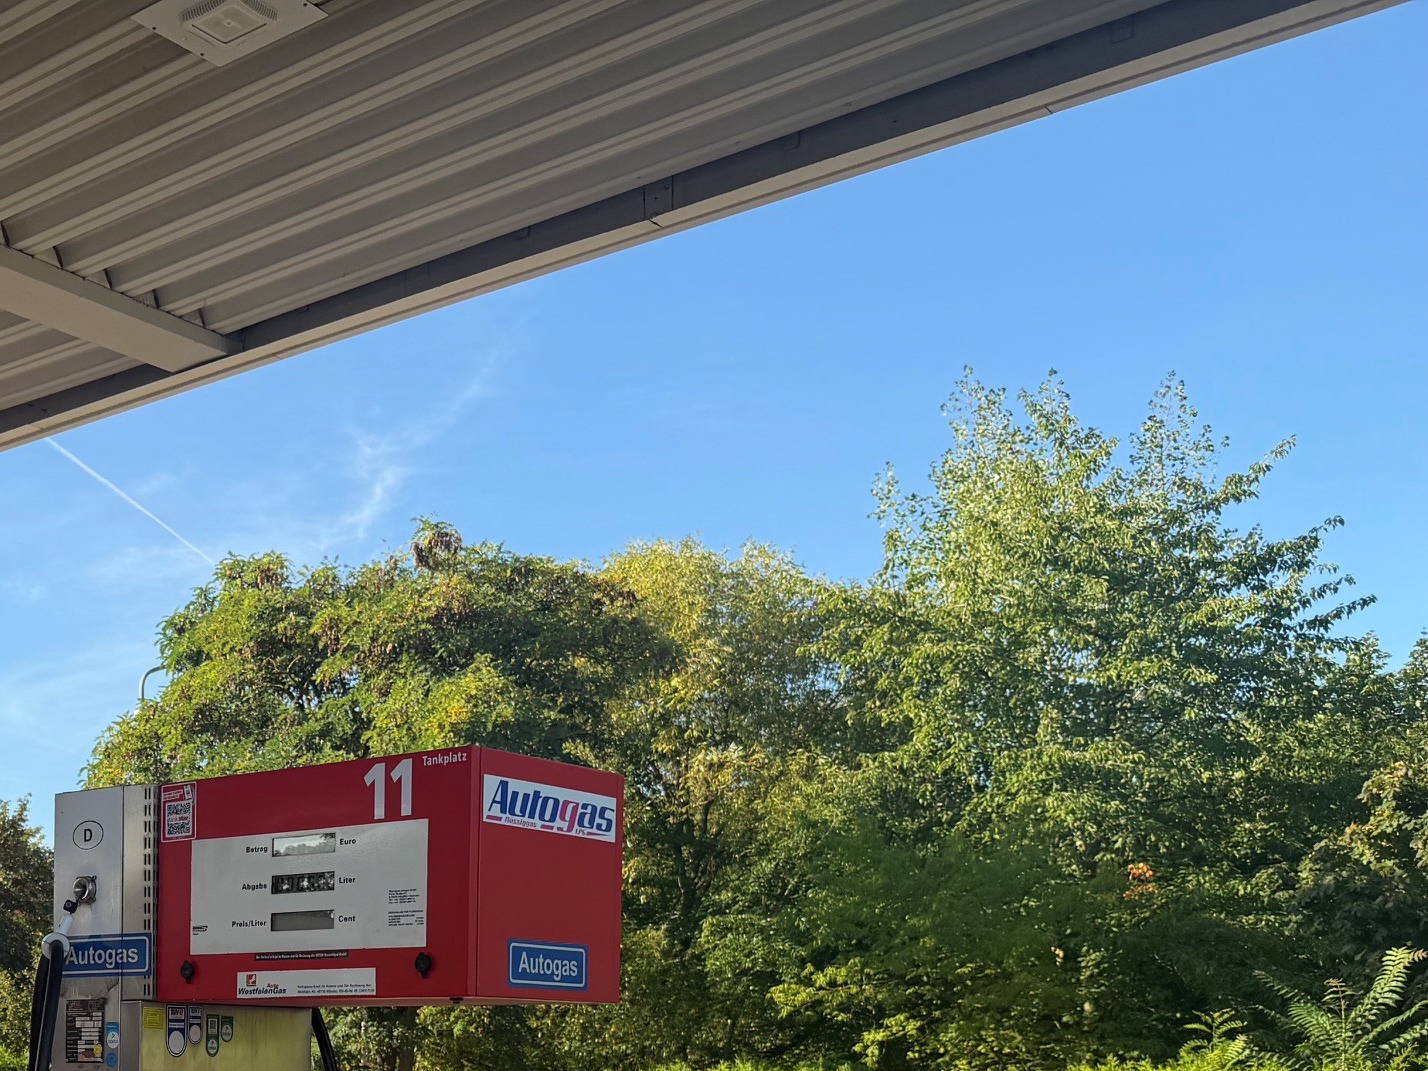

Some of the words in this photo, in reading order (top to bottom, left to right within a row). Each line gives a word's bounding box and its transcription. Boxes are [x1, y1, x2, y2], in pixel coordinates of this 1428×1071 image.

[363, 758, 413, 820] 11
[422, 751, 467, 767] Tankplatz
[488, 780, 615, 833] Autogas
[83, 828, 93, 842] D
[66, 946, 138, 969] Autogas
[518, 951, 578, 980] Autogas
